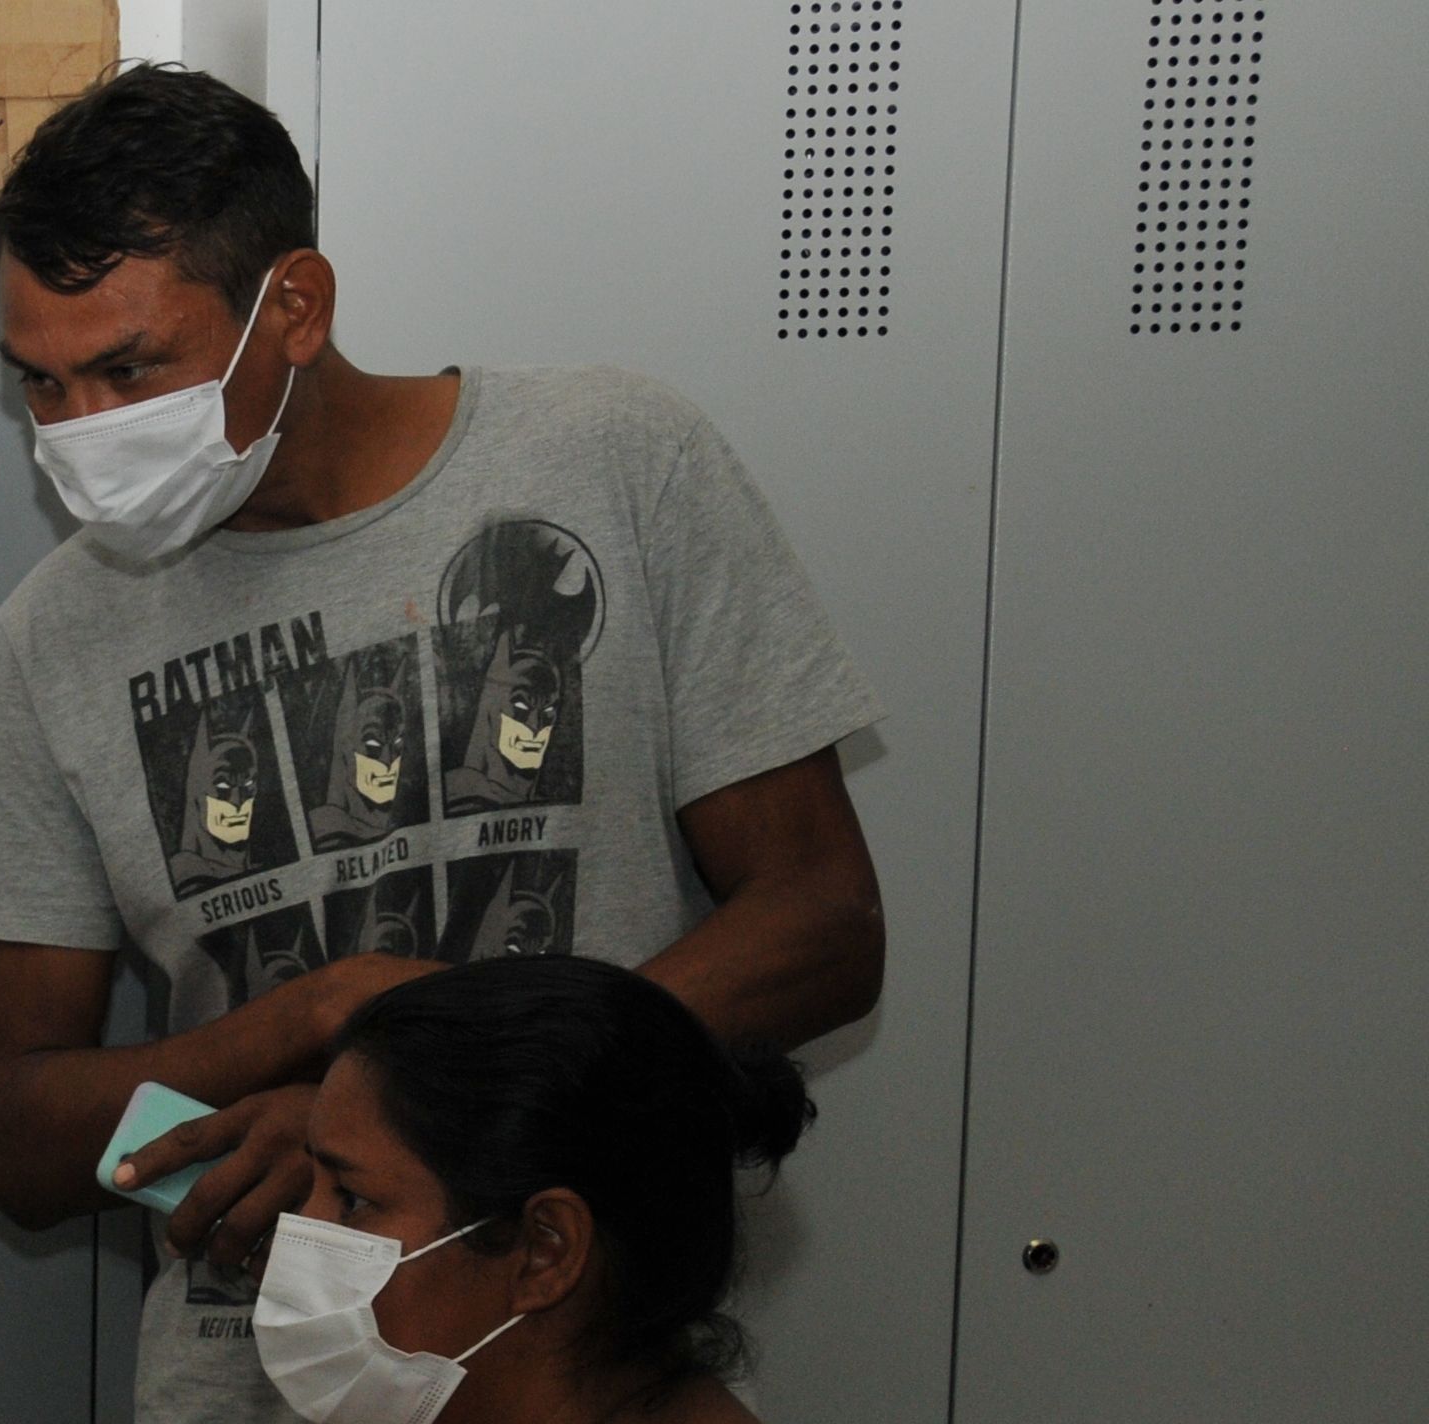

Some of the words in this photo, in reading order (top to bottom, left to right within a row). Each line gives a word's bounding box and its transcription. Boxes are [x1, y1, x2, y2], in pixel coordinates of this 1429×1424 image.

[128, 610, 328, 722] BATMAN
[478, 816, 549, 847] ANGRY
[201, 879, 283, 923] SERIOUS
[198, 1316, 255, 1338] NEUTRA
